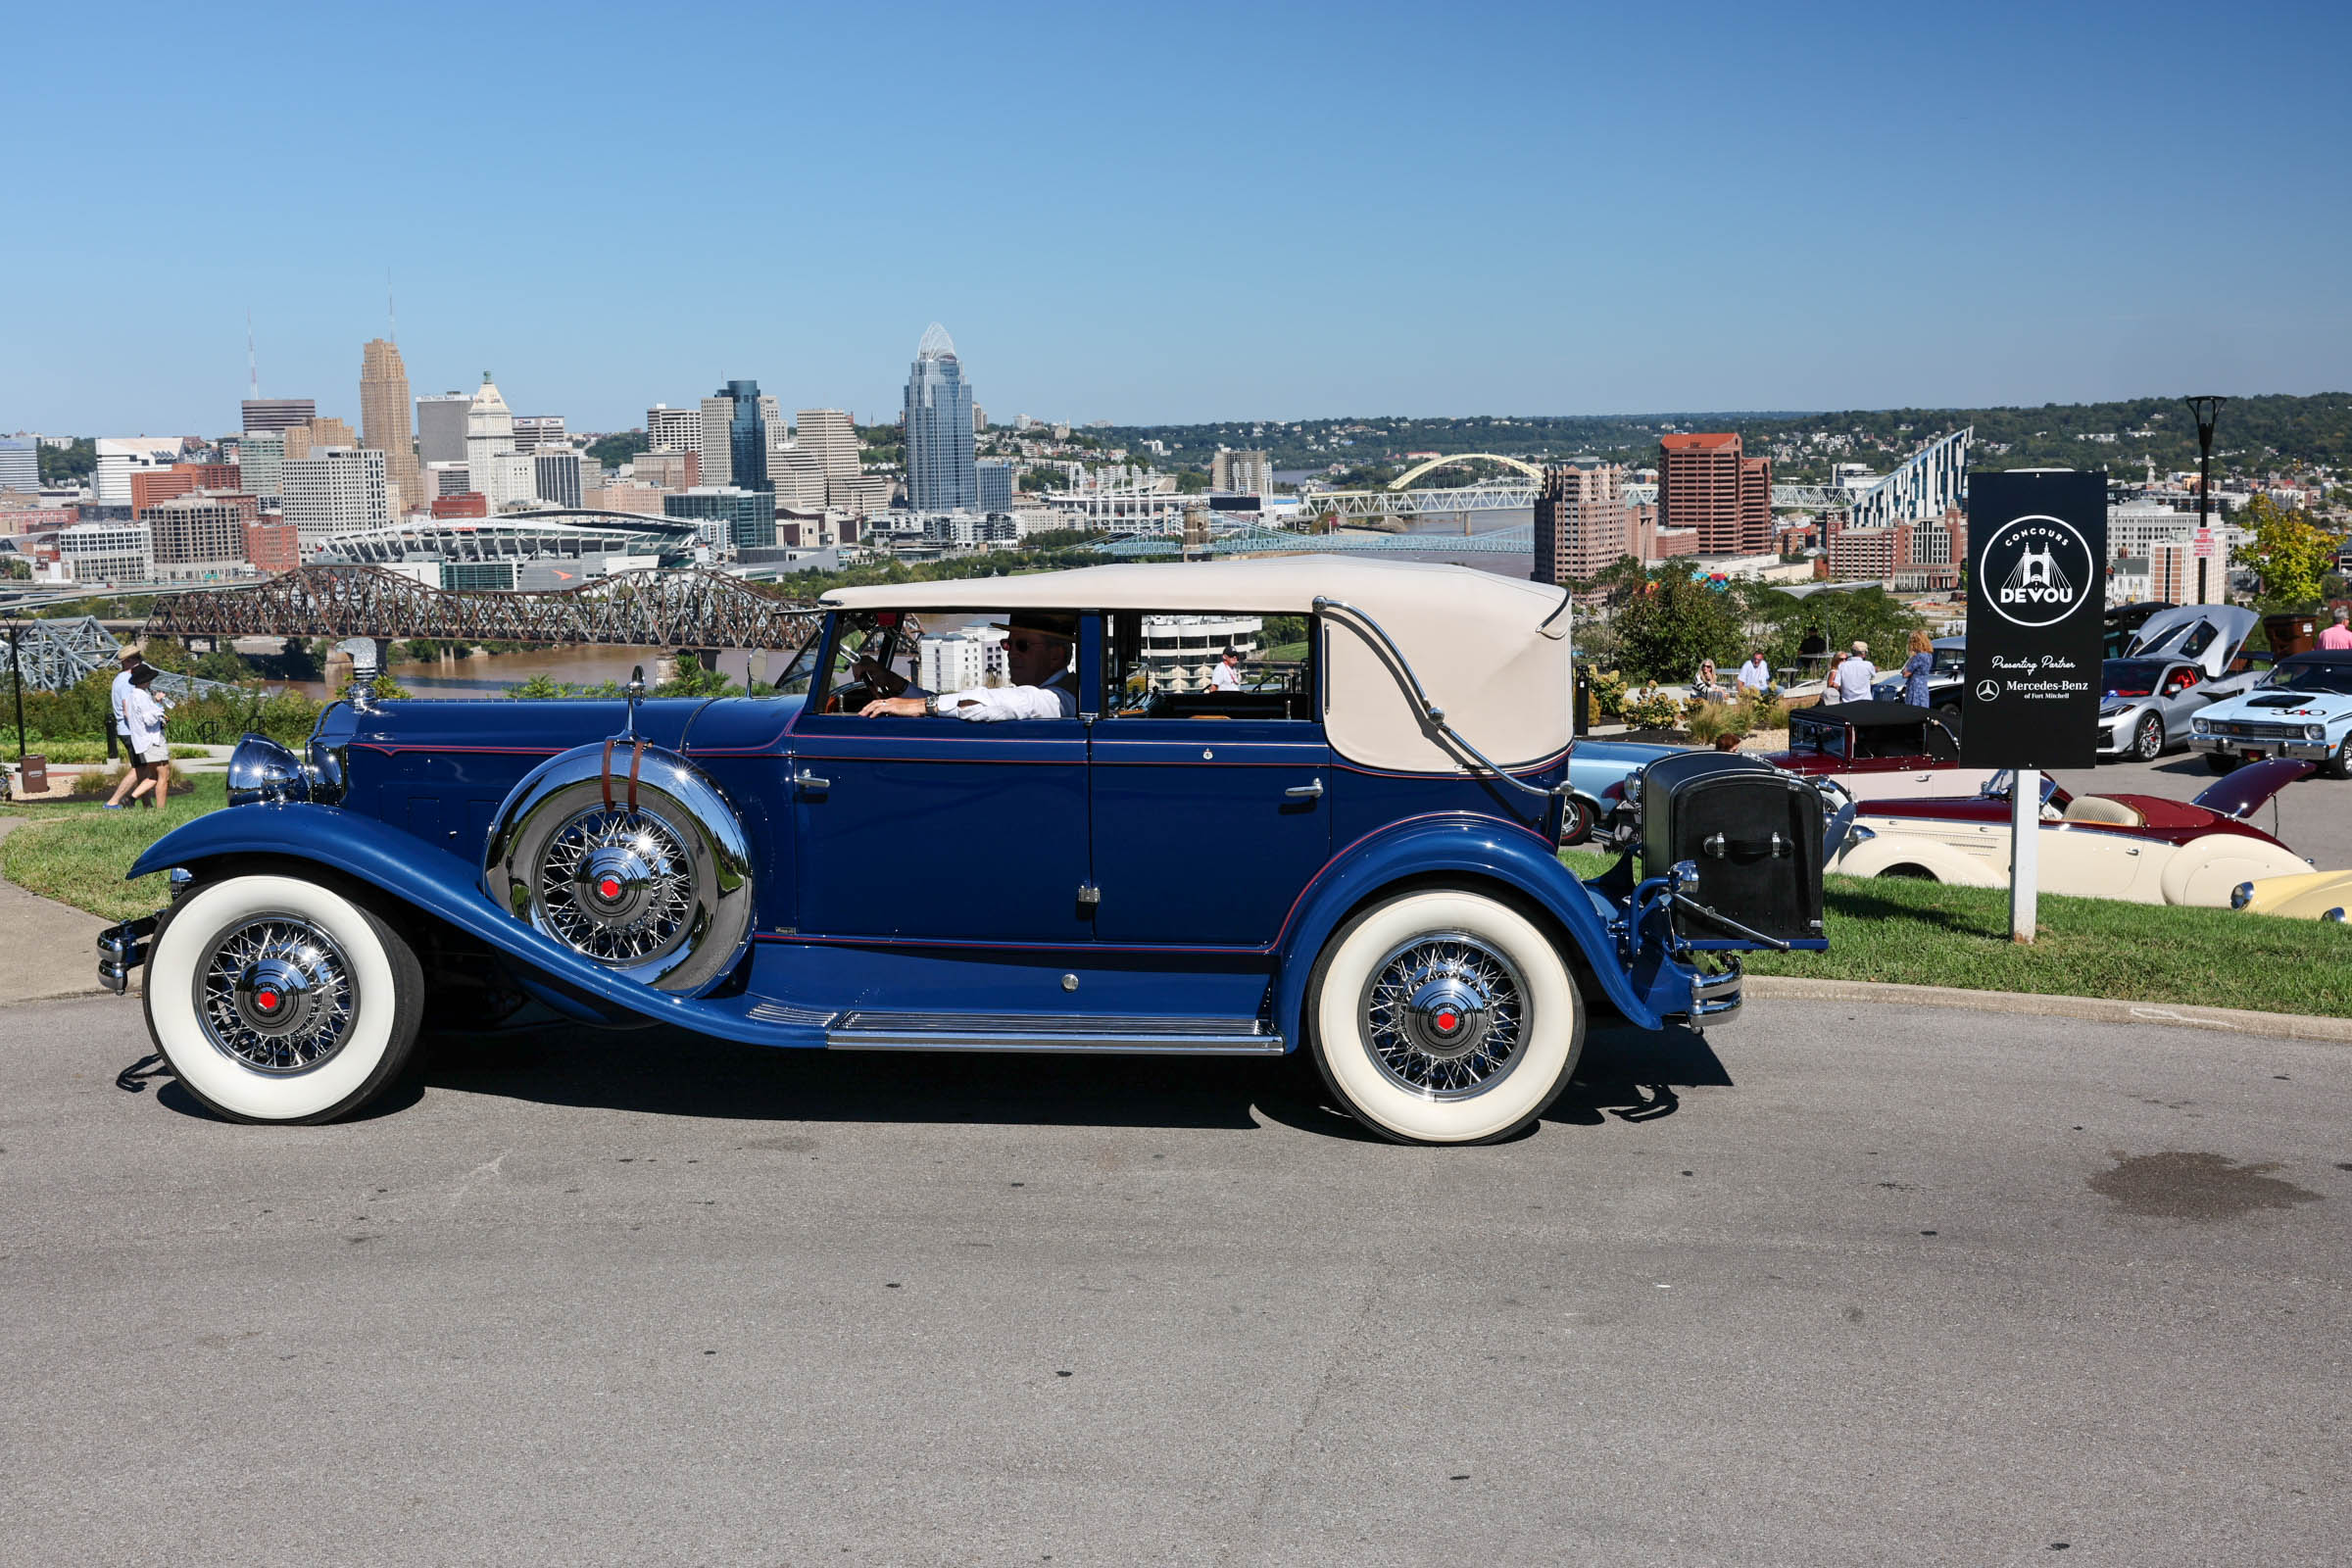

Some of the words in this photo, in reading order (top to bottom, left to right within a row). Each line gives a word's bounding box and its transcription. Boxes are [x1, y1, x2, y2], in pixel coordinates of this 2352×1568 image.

[2005, 527, 2069, 547] CONCOURS
[2000, 587, 2073, 604] DEVOU
[1991, 655, 2038, 676] Presenting
[2041, 655, 2076, 668] Partner
[2006, 680, 2088, 691] Mercedes-Benz
